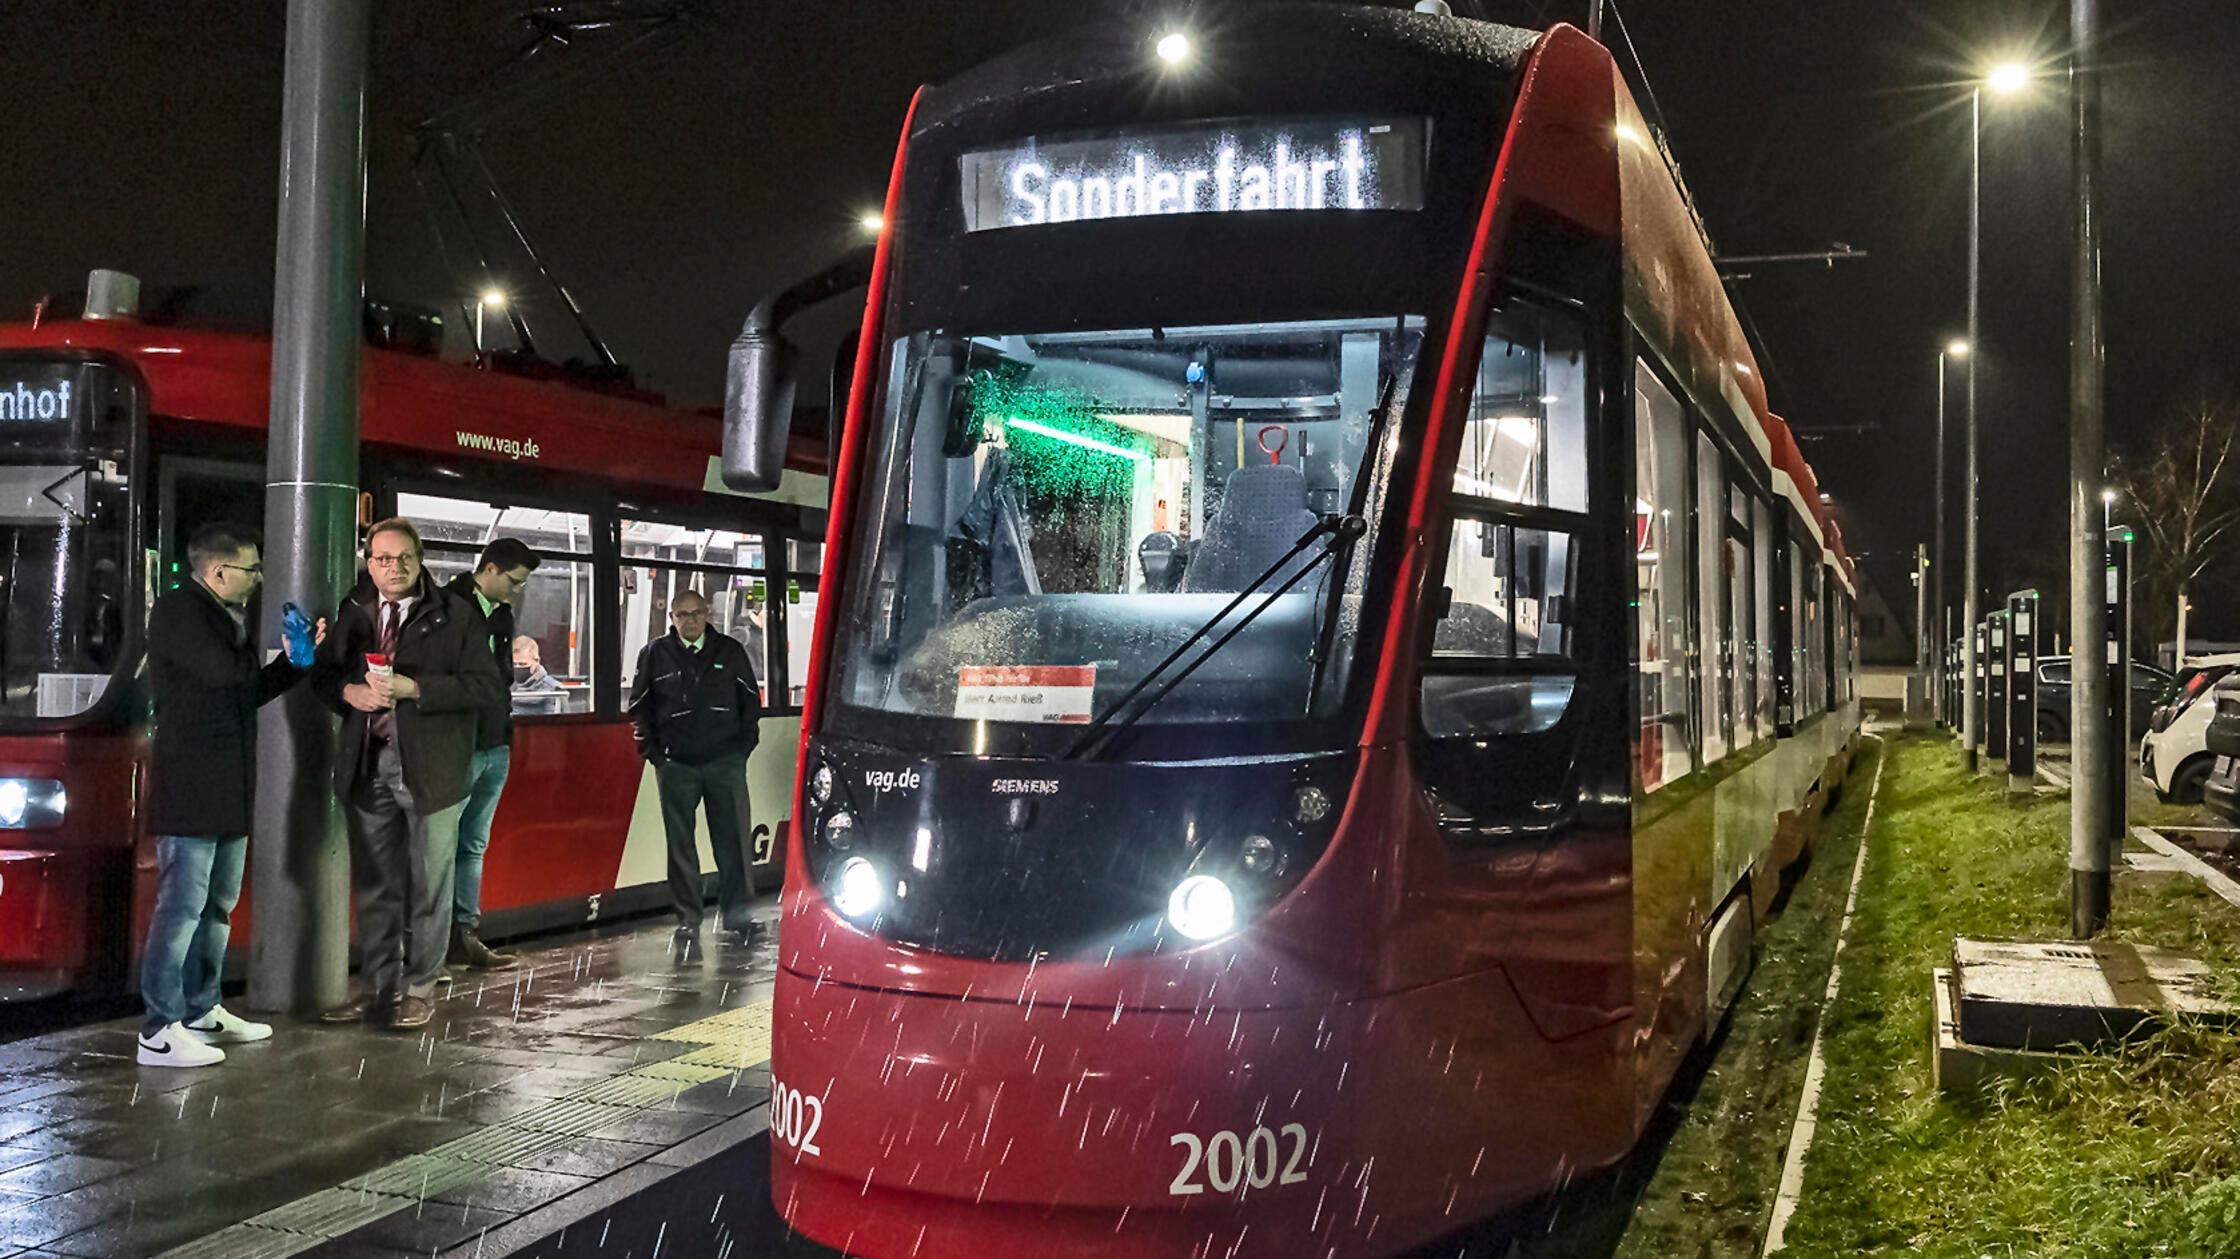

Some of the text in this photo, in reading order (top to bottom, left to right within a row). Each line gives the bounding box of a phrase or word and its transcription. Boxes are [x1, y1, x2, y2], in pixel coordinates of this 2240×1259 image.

[1010, 134, 1367, 225] Sonderfahrt
[456, 431, 540, 460] www.vag.de
[865, 767, 921, 793] vag.de
[991, 779, 1060, 795] SIEMENS
[1169, 1122, 1308, 1196] 2002
